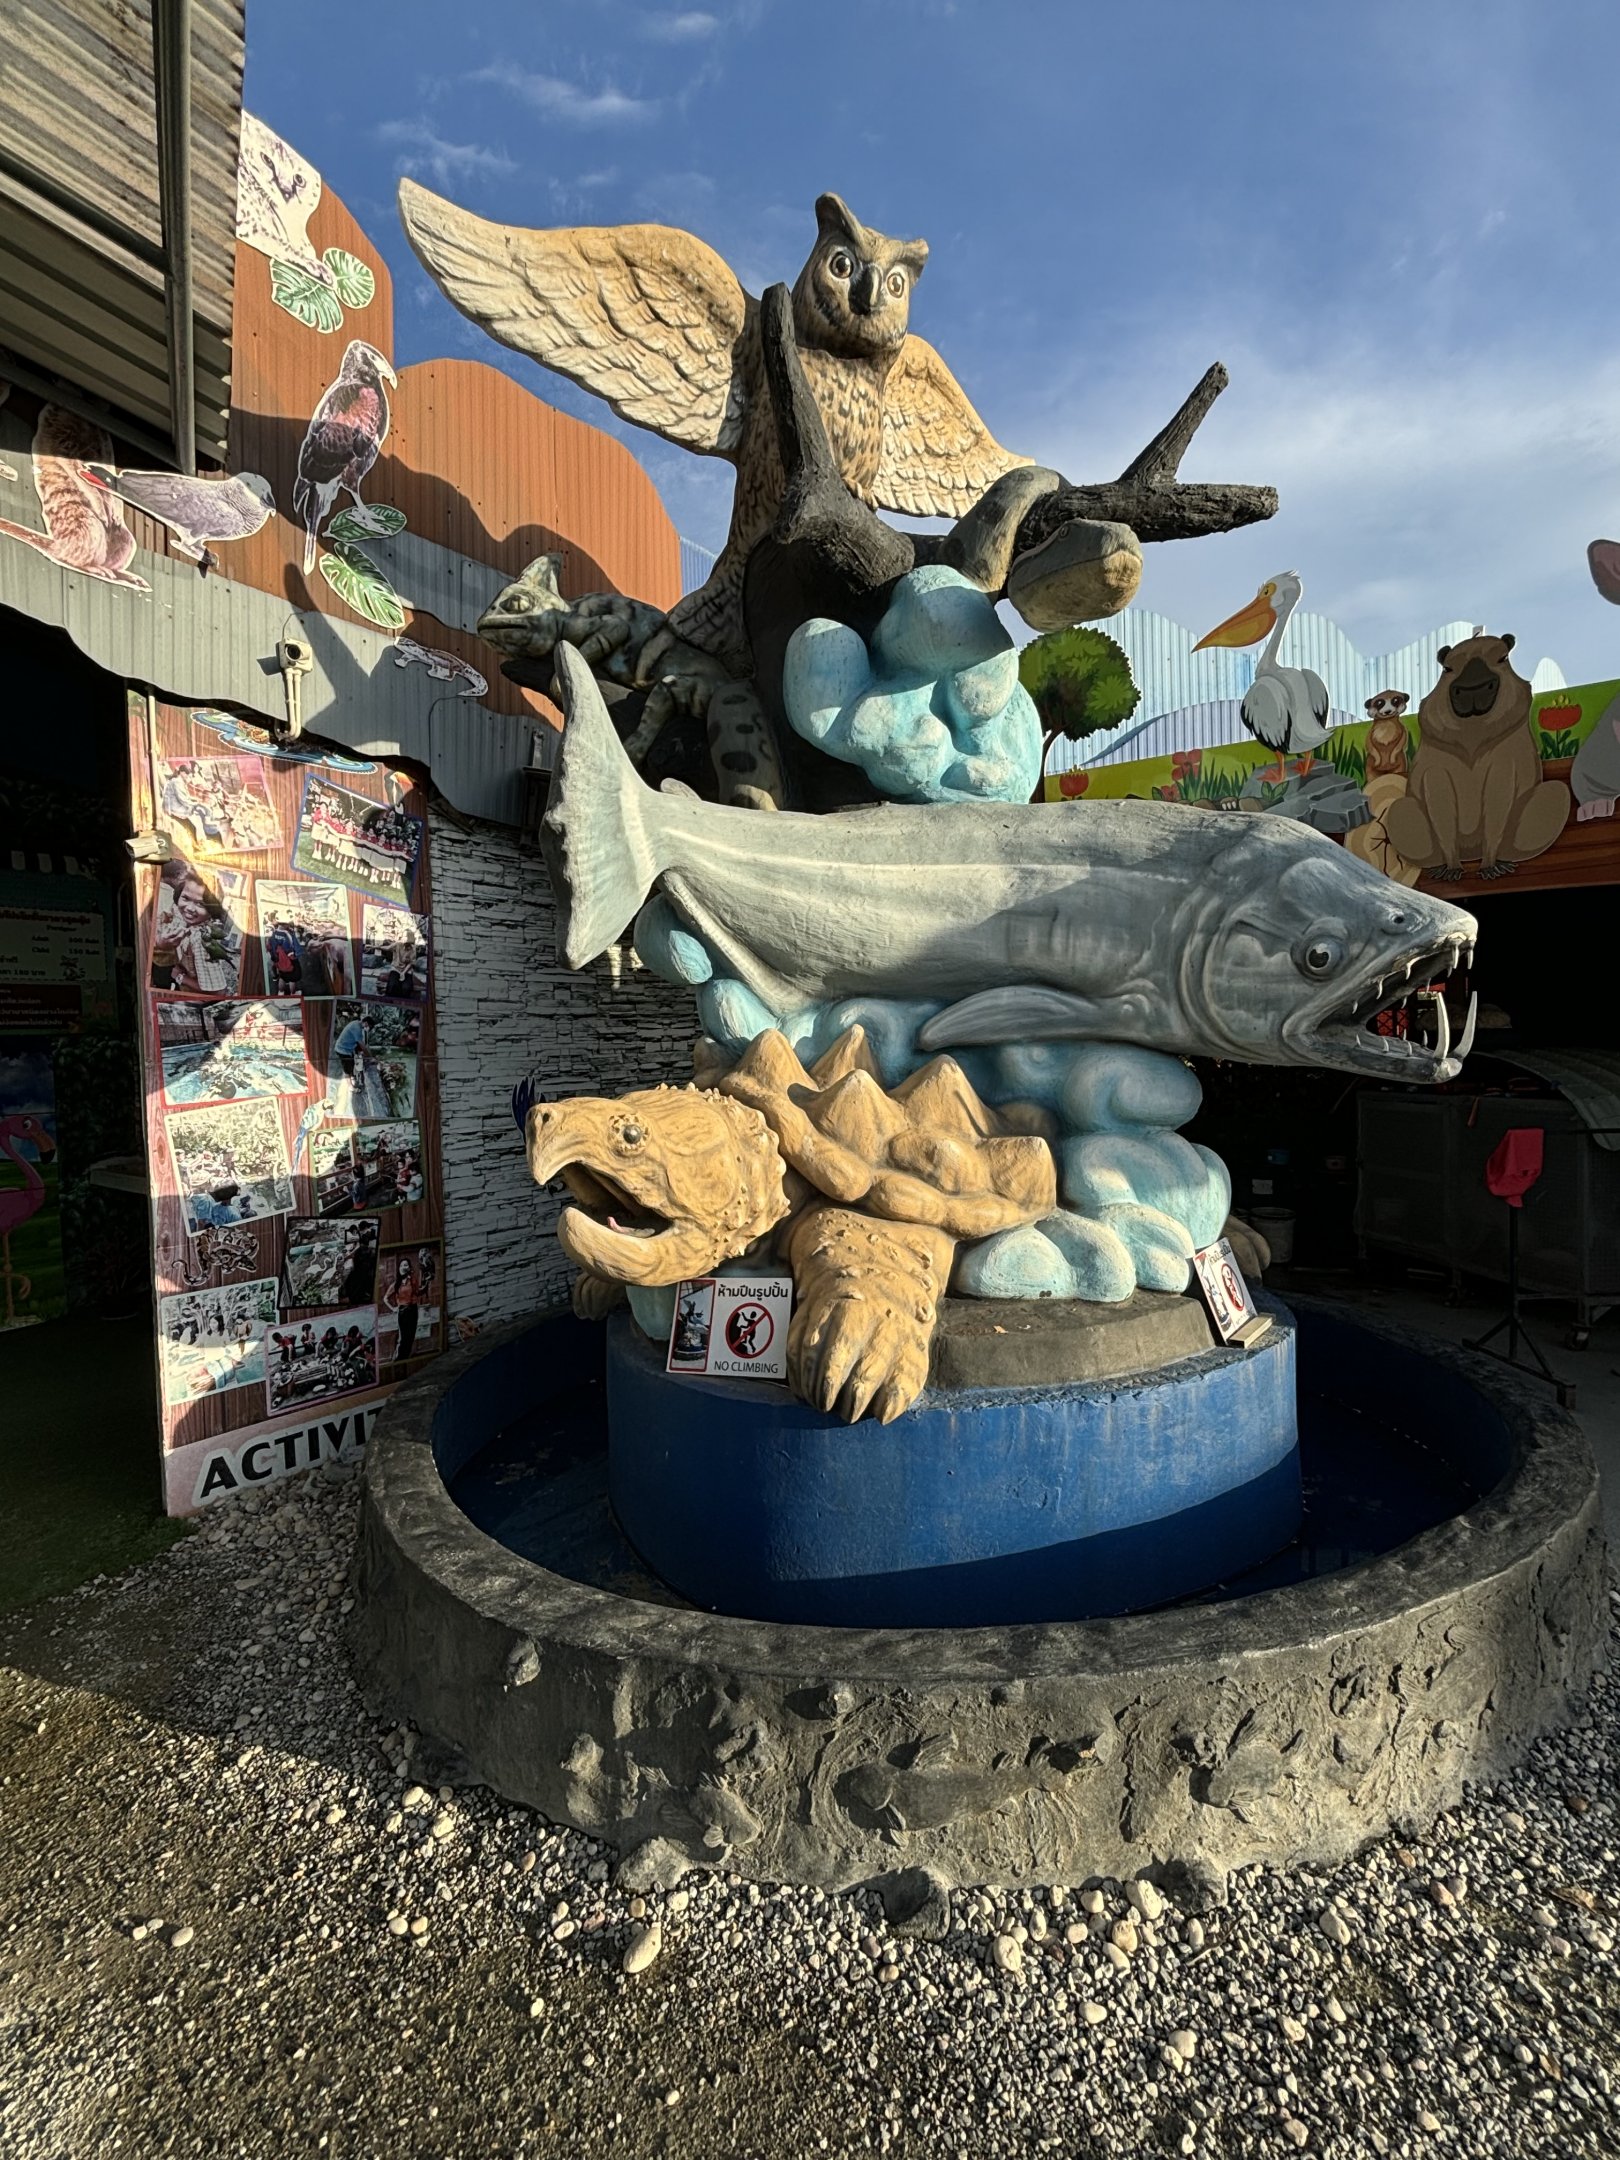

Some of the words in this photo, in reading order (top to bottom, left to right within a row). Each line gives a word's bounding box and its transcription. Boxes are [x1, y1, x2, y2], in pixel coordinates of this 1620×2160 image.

[717, 1282, 788, 1300] ห้ามปีนรูปปั้น
[714, 1361, 729, 1371] NO
[731, 1361, 778, 1373] CLIMBING
